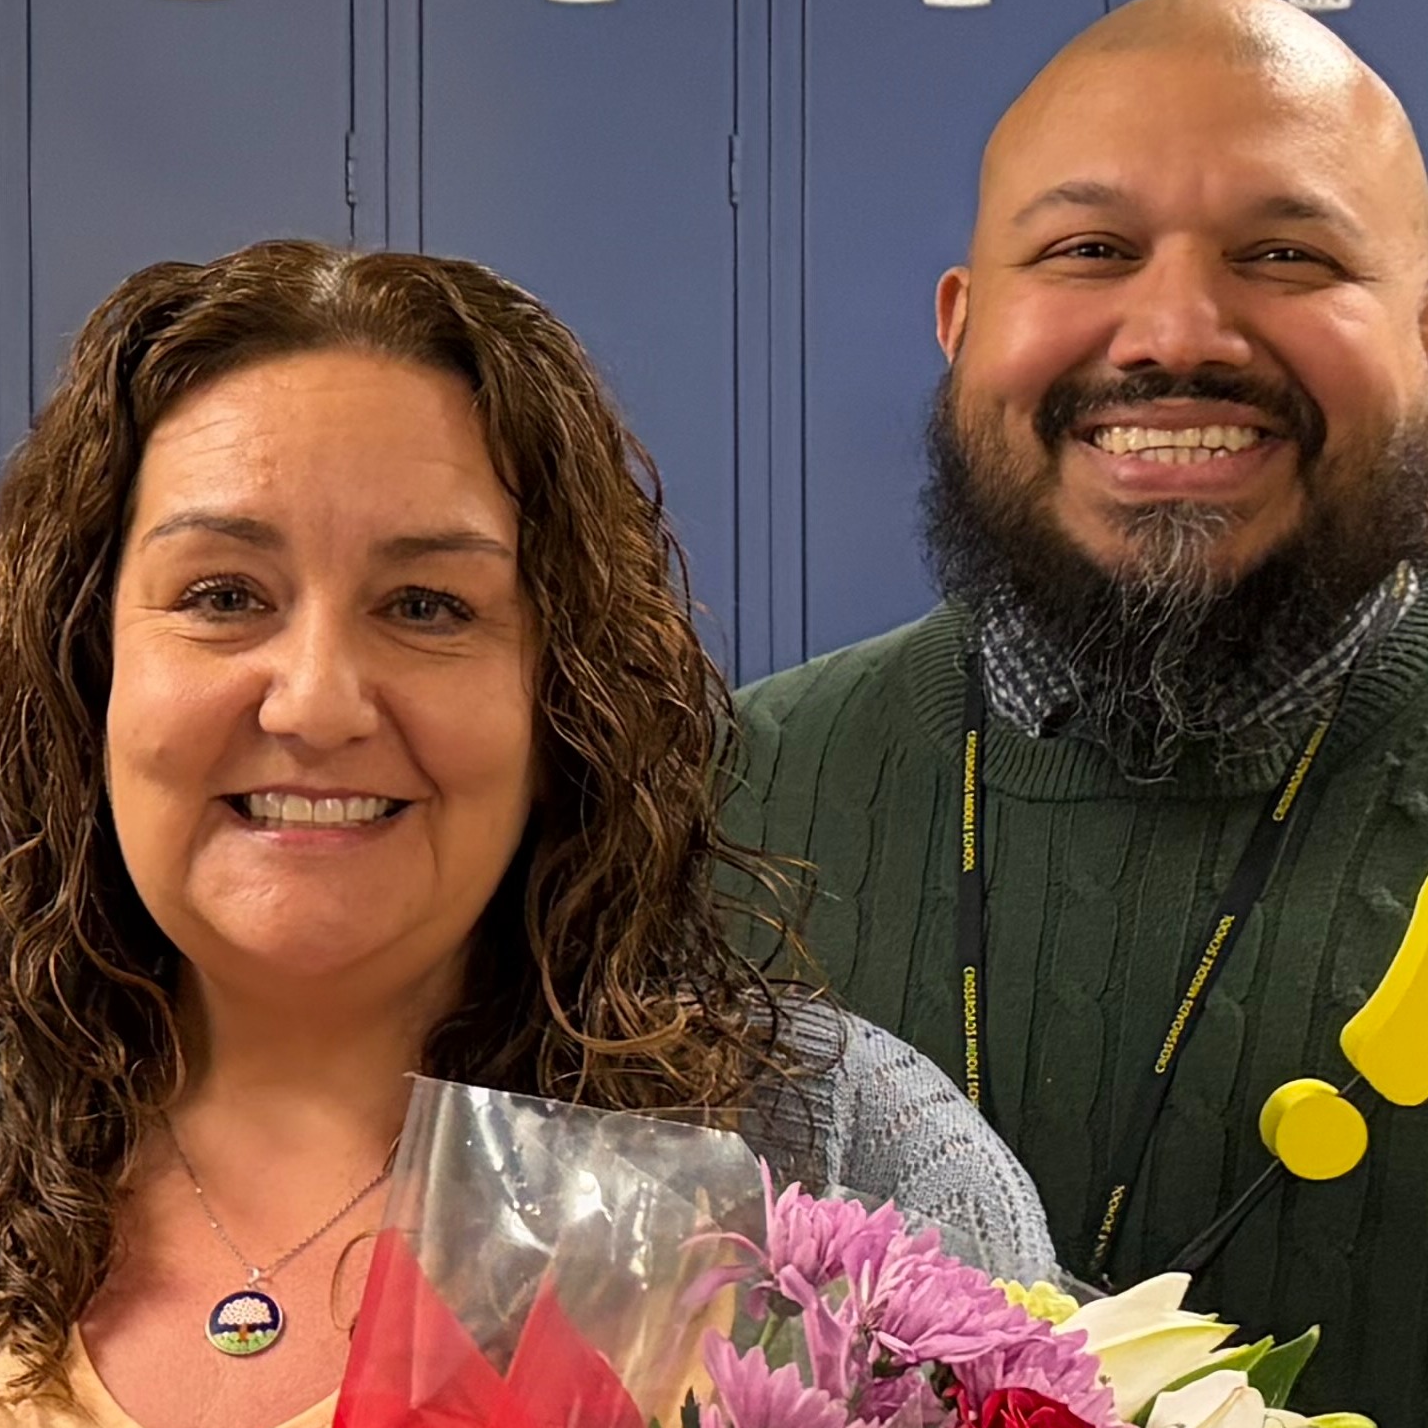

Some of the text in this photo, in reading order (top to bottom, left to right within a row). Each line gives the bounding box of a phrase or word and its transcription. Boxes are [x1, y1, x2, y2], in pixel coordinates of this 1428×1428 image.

[1153, 912, 1236, 1075] CROSSROADS MIDDLE SCHOOL
